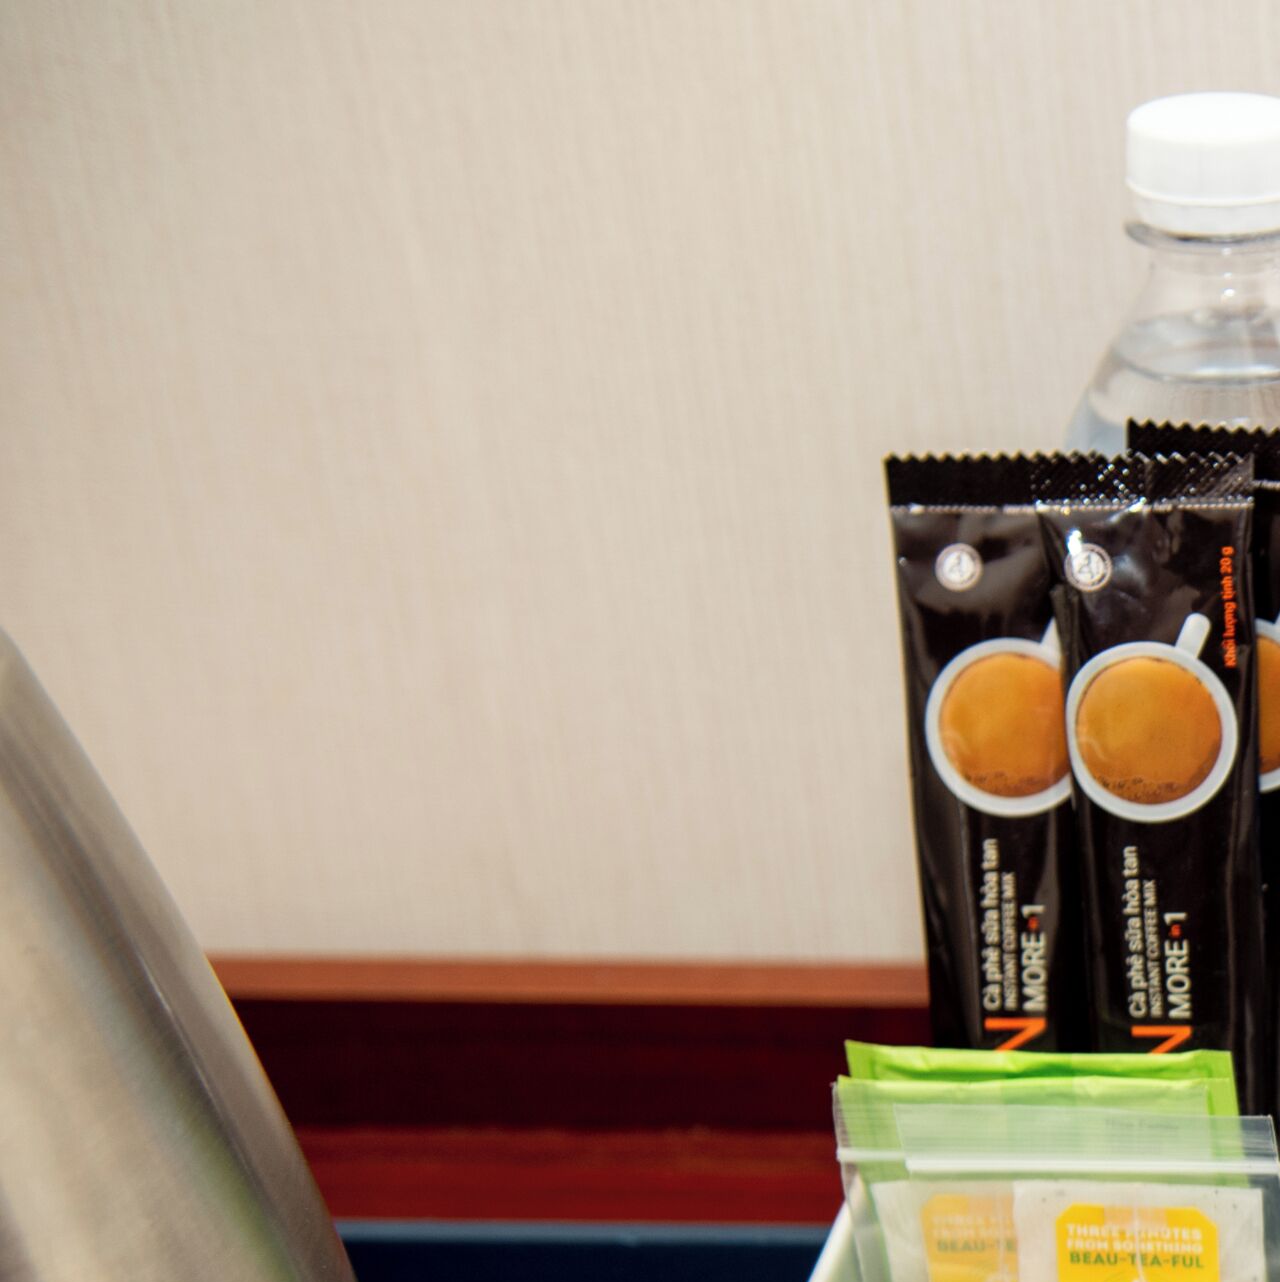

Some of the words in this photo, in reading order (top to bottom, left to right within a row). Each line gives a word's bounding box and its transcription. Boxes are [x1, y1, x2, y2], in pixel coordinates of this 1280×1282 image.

[1220, 557, 1233, 574] 20
[981, 839, 998, 870] tan
[1122, 846, 1139, 877] tan
[1001, 872, 1016, 900] MIX
[1142, 880, 1157, 905] MIX
[1021, 904, 1045, 918] 1
[1164, 912, 1187, 924] 1
[1001, 902, 1017, 951] COFFEE
[1144, 908, 1161, 958] COFFEE
[1002, 953, 1018, 1010] INSTANT
[1020, 931, 1047, 1012] MORE
[1165, 940, 1192, 1019] MORE
[1147, 960, 1163, 1018] INSTANT
[1067, 1223, 1121, 1239] THREE
[1067, 1238, 1108, 1251] FROM
[1070, 1252, 1205, 1268] BEAU-TEA-FUL
